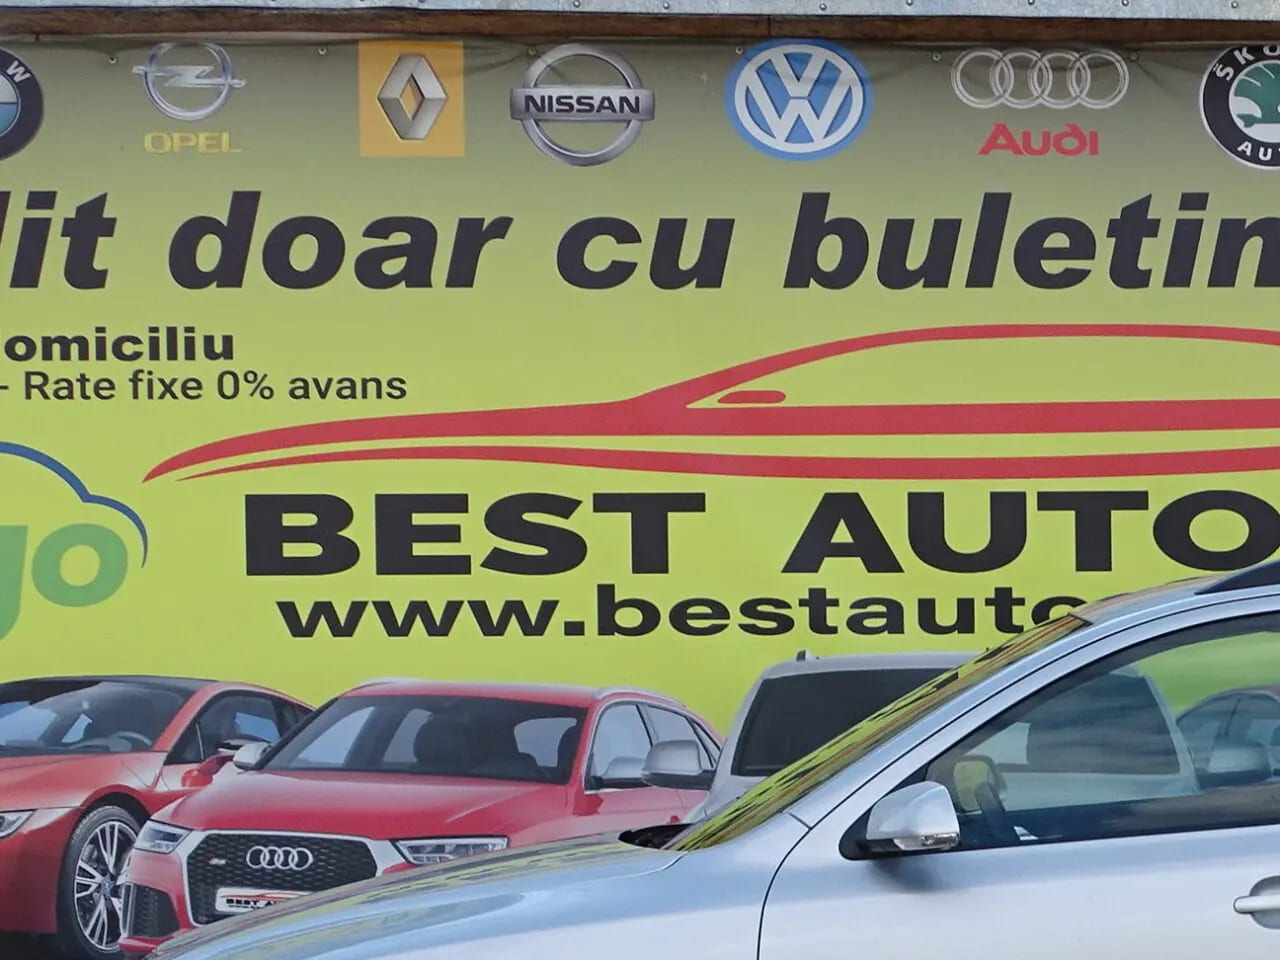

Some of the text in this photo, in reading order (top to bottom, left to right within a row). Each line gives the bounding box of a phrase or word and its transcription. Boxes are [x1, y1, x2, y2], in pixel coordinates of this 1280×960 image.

[524, 94, 640, 114] NISSAN
[143, 131, 241, 154] OPEL
[978, 122, 1099, 156] Audi
[0, 191, 117, 289] it
[168, 191, 513, 289] doar
[556, 217, 735, 289] cu
[4, 326, 235, 362] omiciliu
[24, 371, 116, 400] Rate
[128, 369, 203, 400] fixe
[217, 371, 275, 400] 0%
[288, 376, 407, 400] avans
[244, 492, 706, 576] BEST
